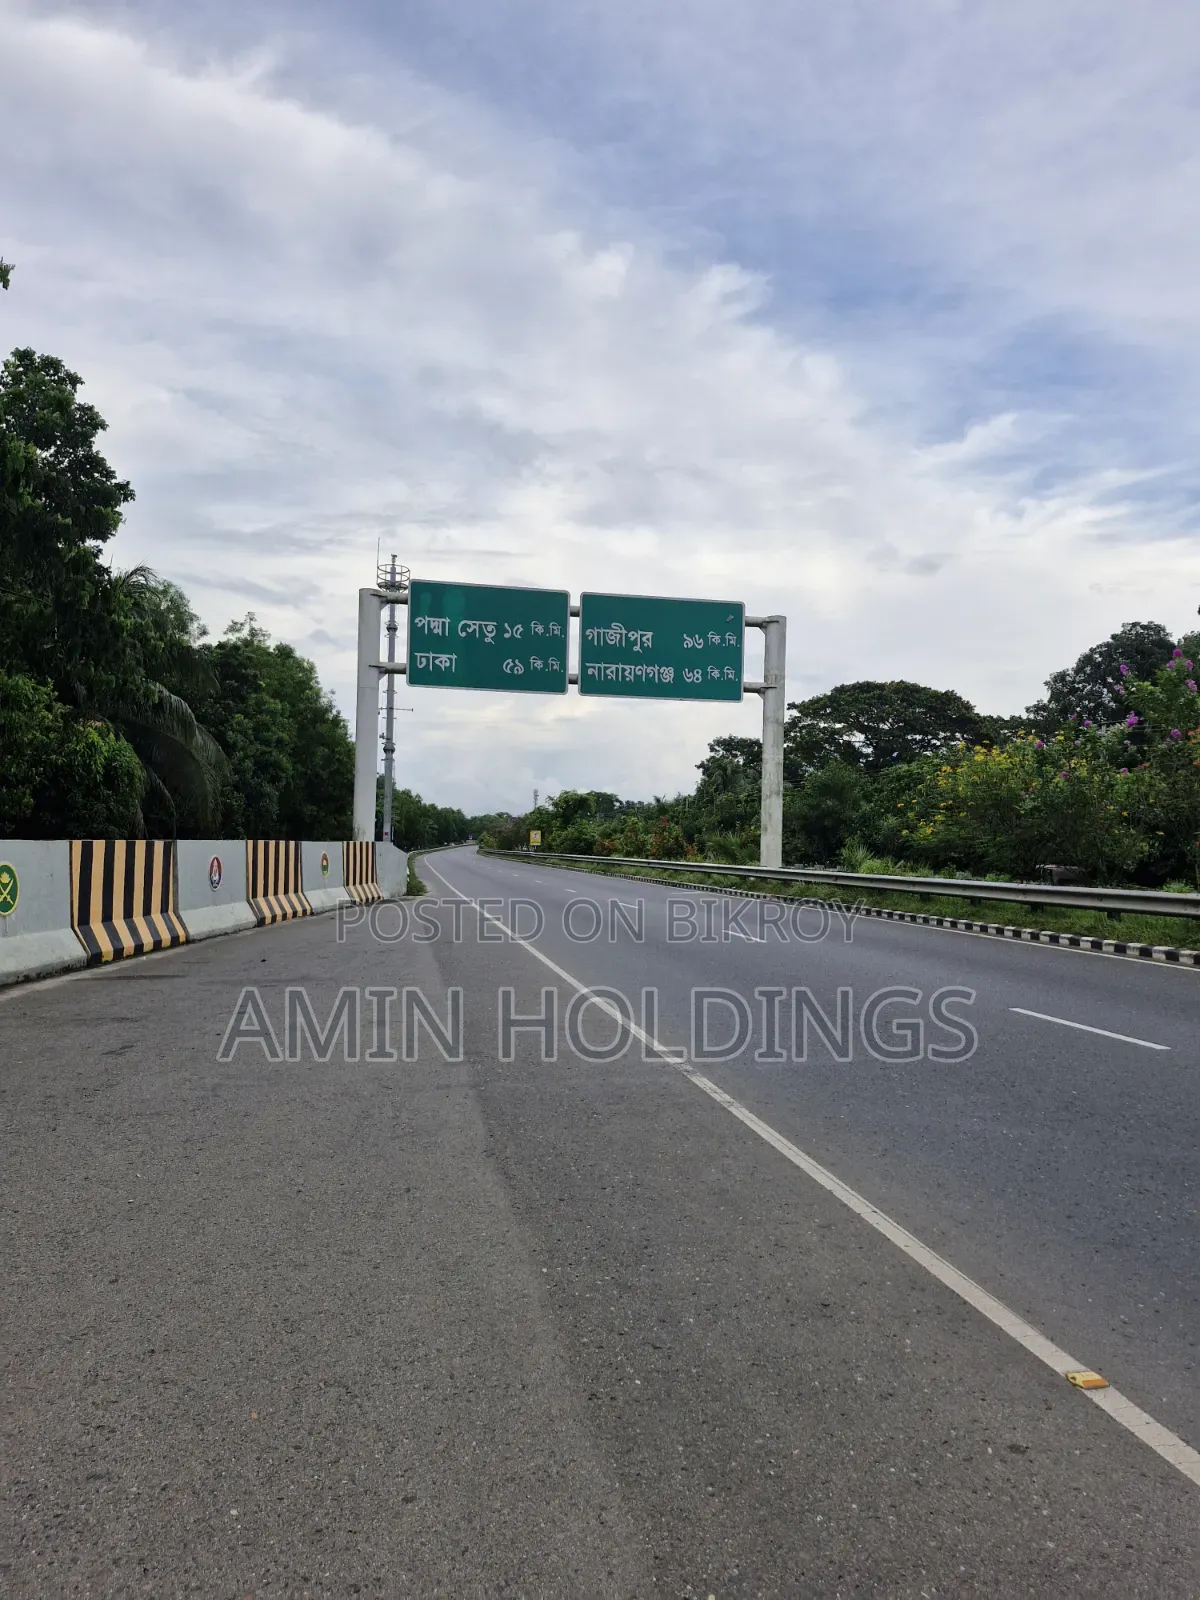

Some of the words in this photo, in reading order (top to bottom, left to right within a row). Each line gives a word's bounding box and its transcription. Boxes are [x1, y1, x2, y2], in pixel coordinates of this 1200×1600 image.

[414, 615, 450, 636] পদ্মা
[458, 620, 498, 644] সেতু
[503, 622, 524, 639] ১৫
[585, 622, 653, 653] গাজীপুর
[683, 633, 703, 649] ৯৬
[414, 651, 458, 673] ঢাকা
[502, 658, 525, 675] ৫৯
[585, 661, 675, 684] নারায়ণগঞ্জ
[682, 668, 702, 683] ৬৪
